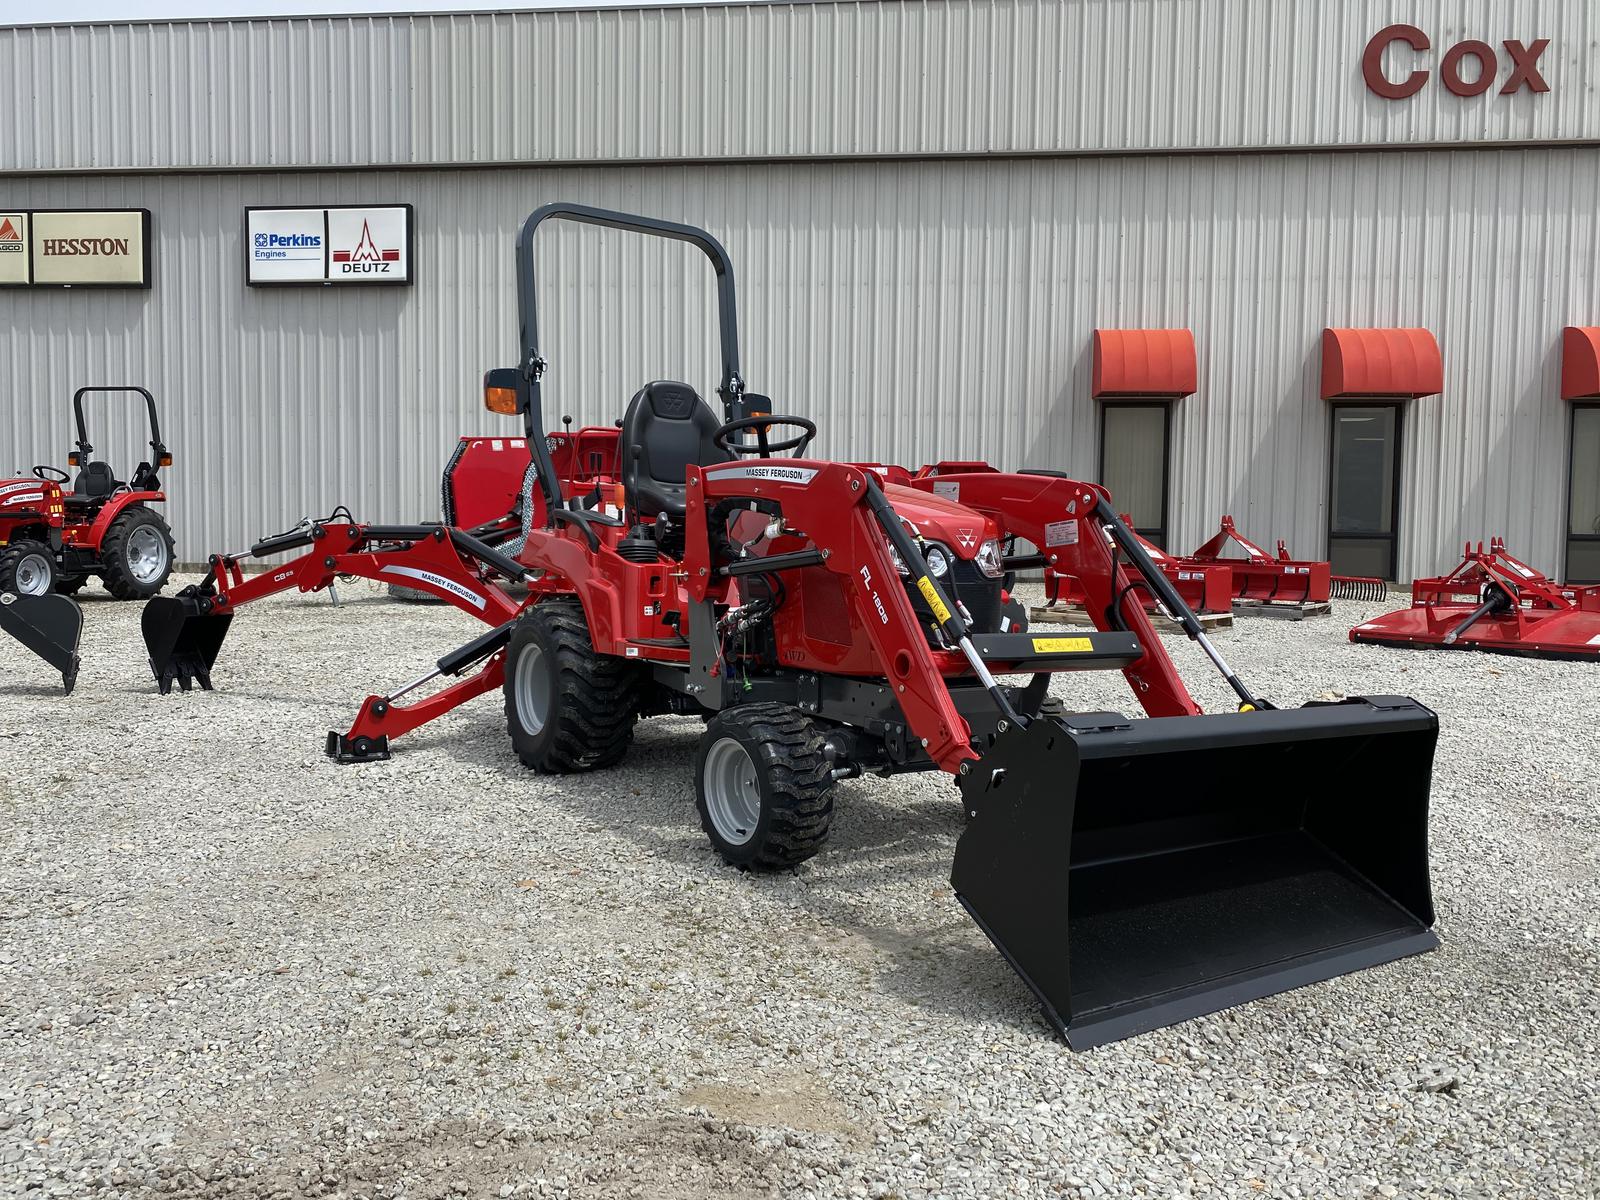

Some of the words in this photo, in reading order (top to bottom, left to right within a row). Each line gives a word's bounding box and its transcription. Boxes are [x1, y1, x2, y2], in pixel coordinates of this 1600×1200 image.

[1362, 24, 1551, 99] Cox
[43, 238, 129, 256] HESSTON
[269, 234, 321, 247] Perkins
[255, 250, 286, 258] Engines
[342, 263, 390, 273] DEUTZ
[746, 469, 769, 477] MASSEY
[770, 469, 803, 479] FERGUSON
[860, 565, 871, 591] FL
[421, 573, 446, 587] MASSEY
[446, 582, 478, 602] FERGUSON
